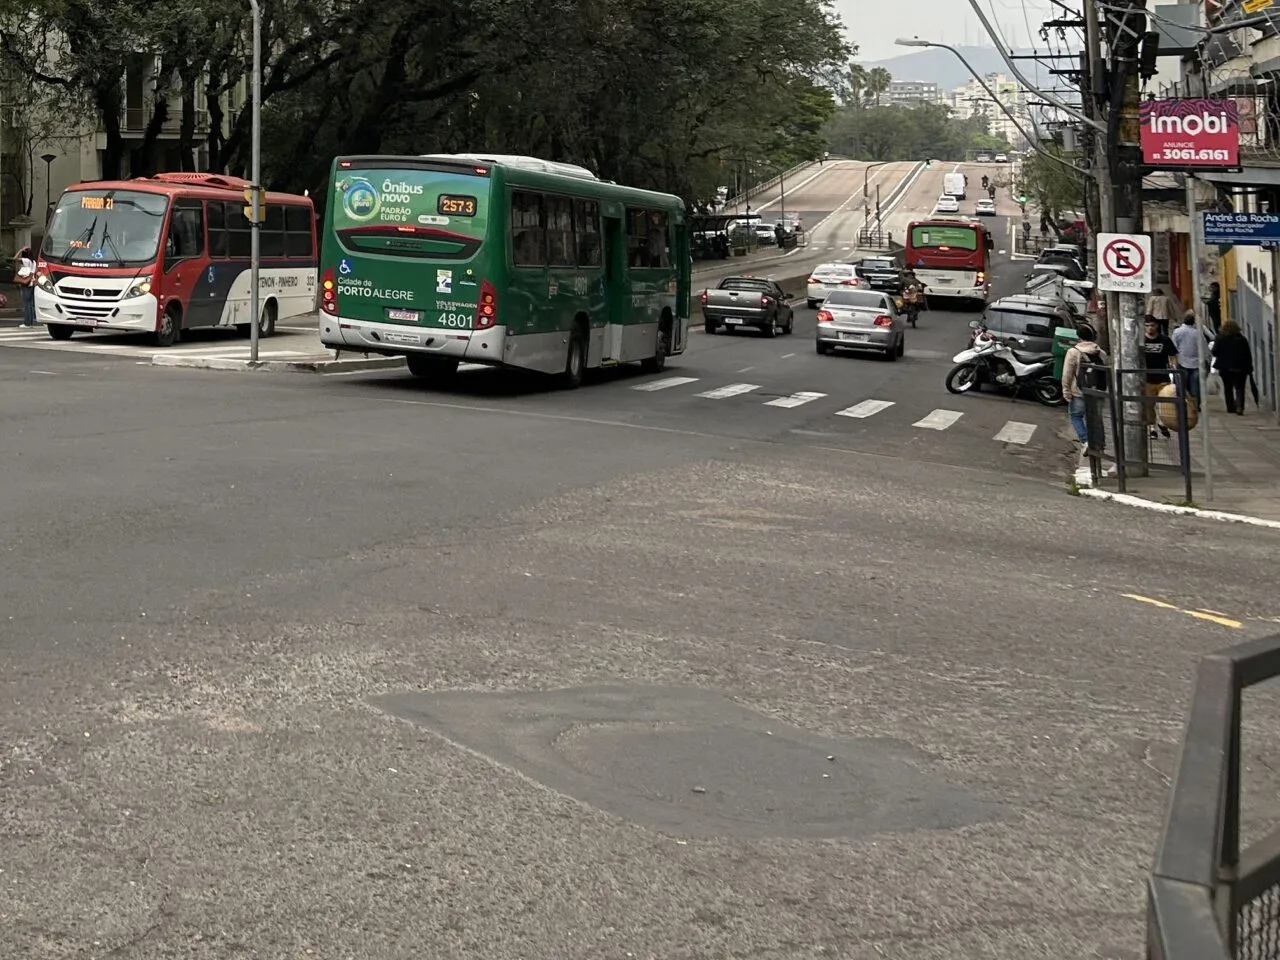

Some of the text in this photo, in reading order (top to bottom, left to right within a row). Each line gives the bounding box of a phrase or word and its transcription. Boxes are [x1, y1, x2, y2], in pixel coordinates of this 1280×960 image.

[1150, 112, 1228, 136] imobi
[1163, 149, 1229, 160] 3061.6161
[382, 178, 424, 194] Ônibus
[381, 193, 410, 203] novo
[106, 198, 113, 210] 21
[442, 199, 474, 213] 2573
[380, 206, 412, 215] PADRÃO
[380, 214, 407, 222] EURO 6
[1205, 213, 1279, 223] André da Rocha
[259, 276, 276, 288] TENON
[337, 277, 362, 286] Cidade
[337, 286, 414, 301] PORTO ALEGRE
[436, 300, 478, 309] VOLKSWAGEN
[438, 313, 473, 328] 4801
